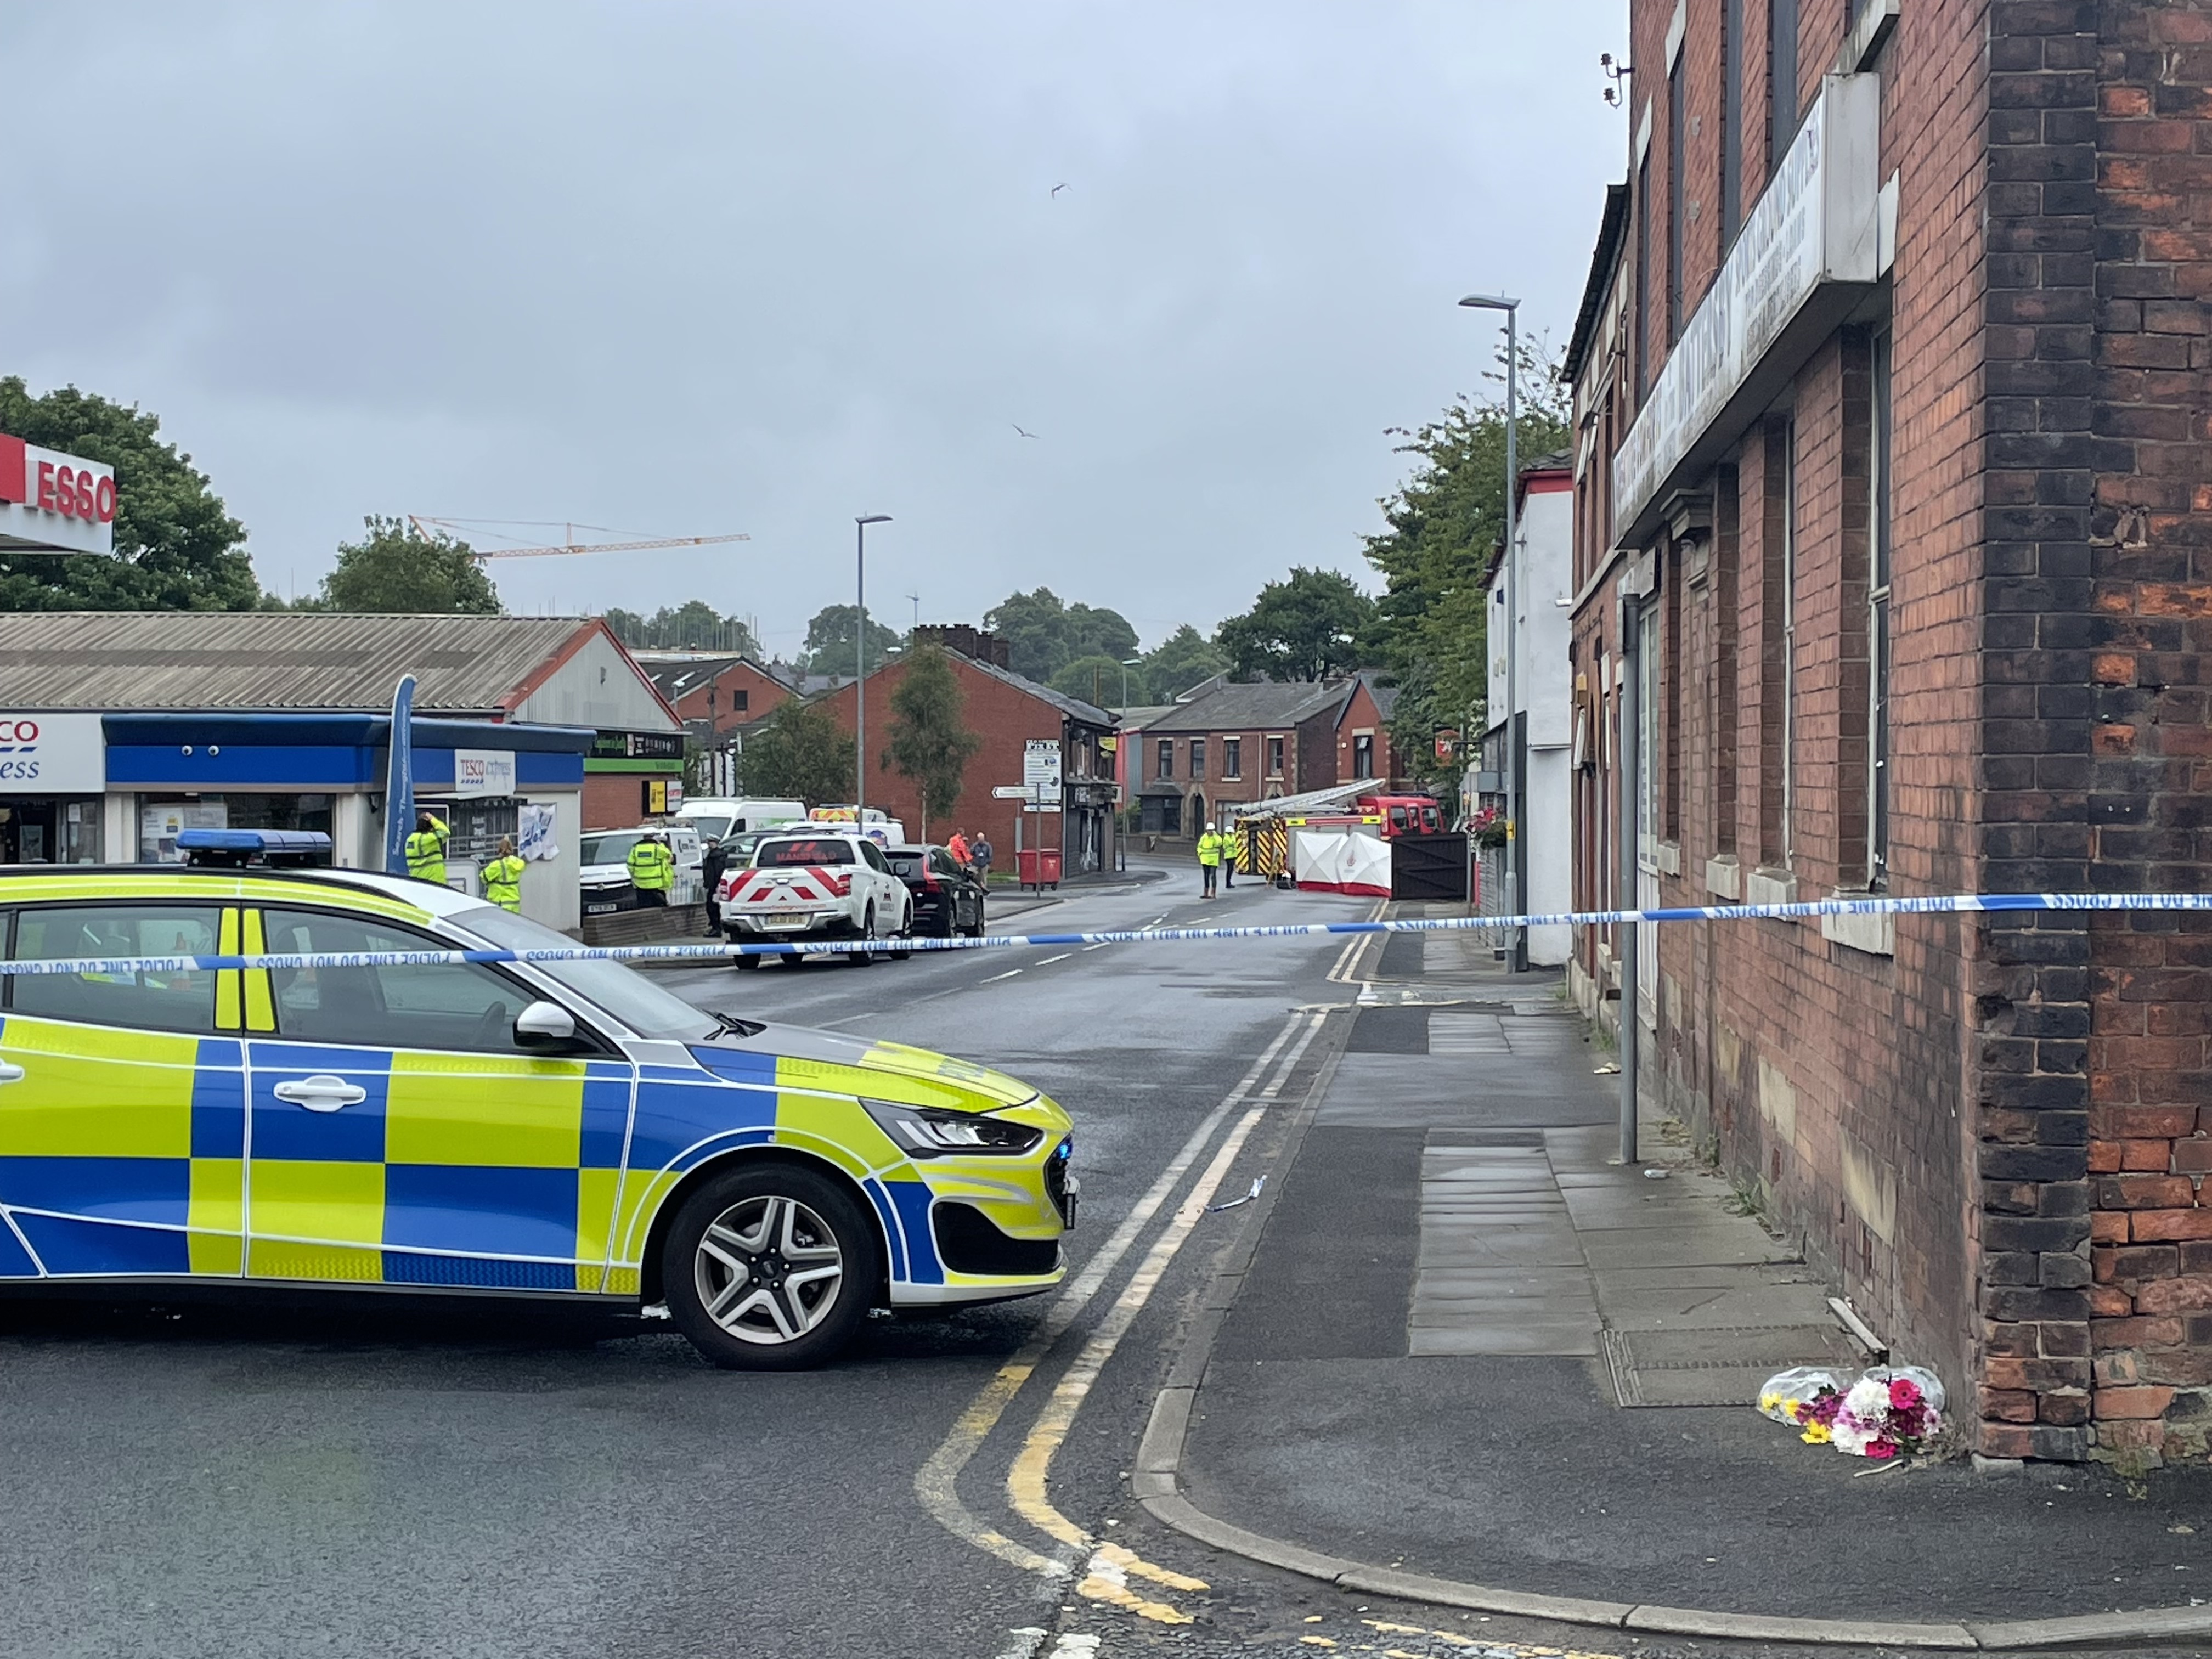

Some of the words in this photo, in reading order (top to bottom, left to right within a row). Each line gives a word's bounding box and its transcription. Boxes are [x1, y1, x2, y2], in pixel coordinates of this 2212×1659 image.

[38, 461, 116, 523] ESSO
[460, 759, 484, 776] TESCO
[257, 957, 302, 968] CROSS
[311, 956, 336, 967] NOT
[341, 955, 362, 967] DO
[365, 954, 396, 966] LINE
[401, 952, 451, 964] POLICE
[49, 962, 73, 973] NOT
[78, 962, 96, 973] DO
[101, 961, 131, 972] LINE
[136, 959, 183, 971] POLICE
